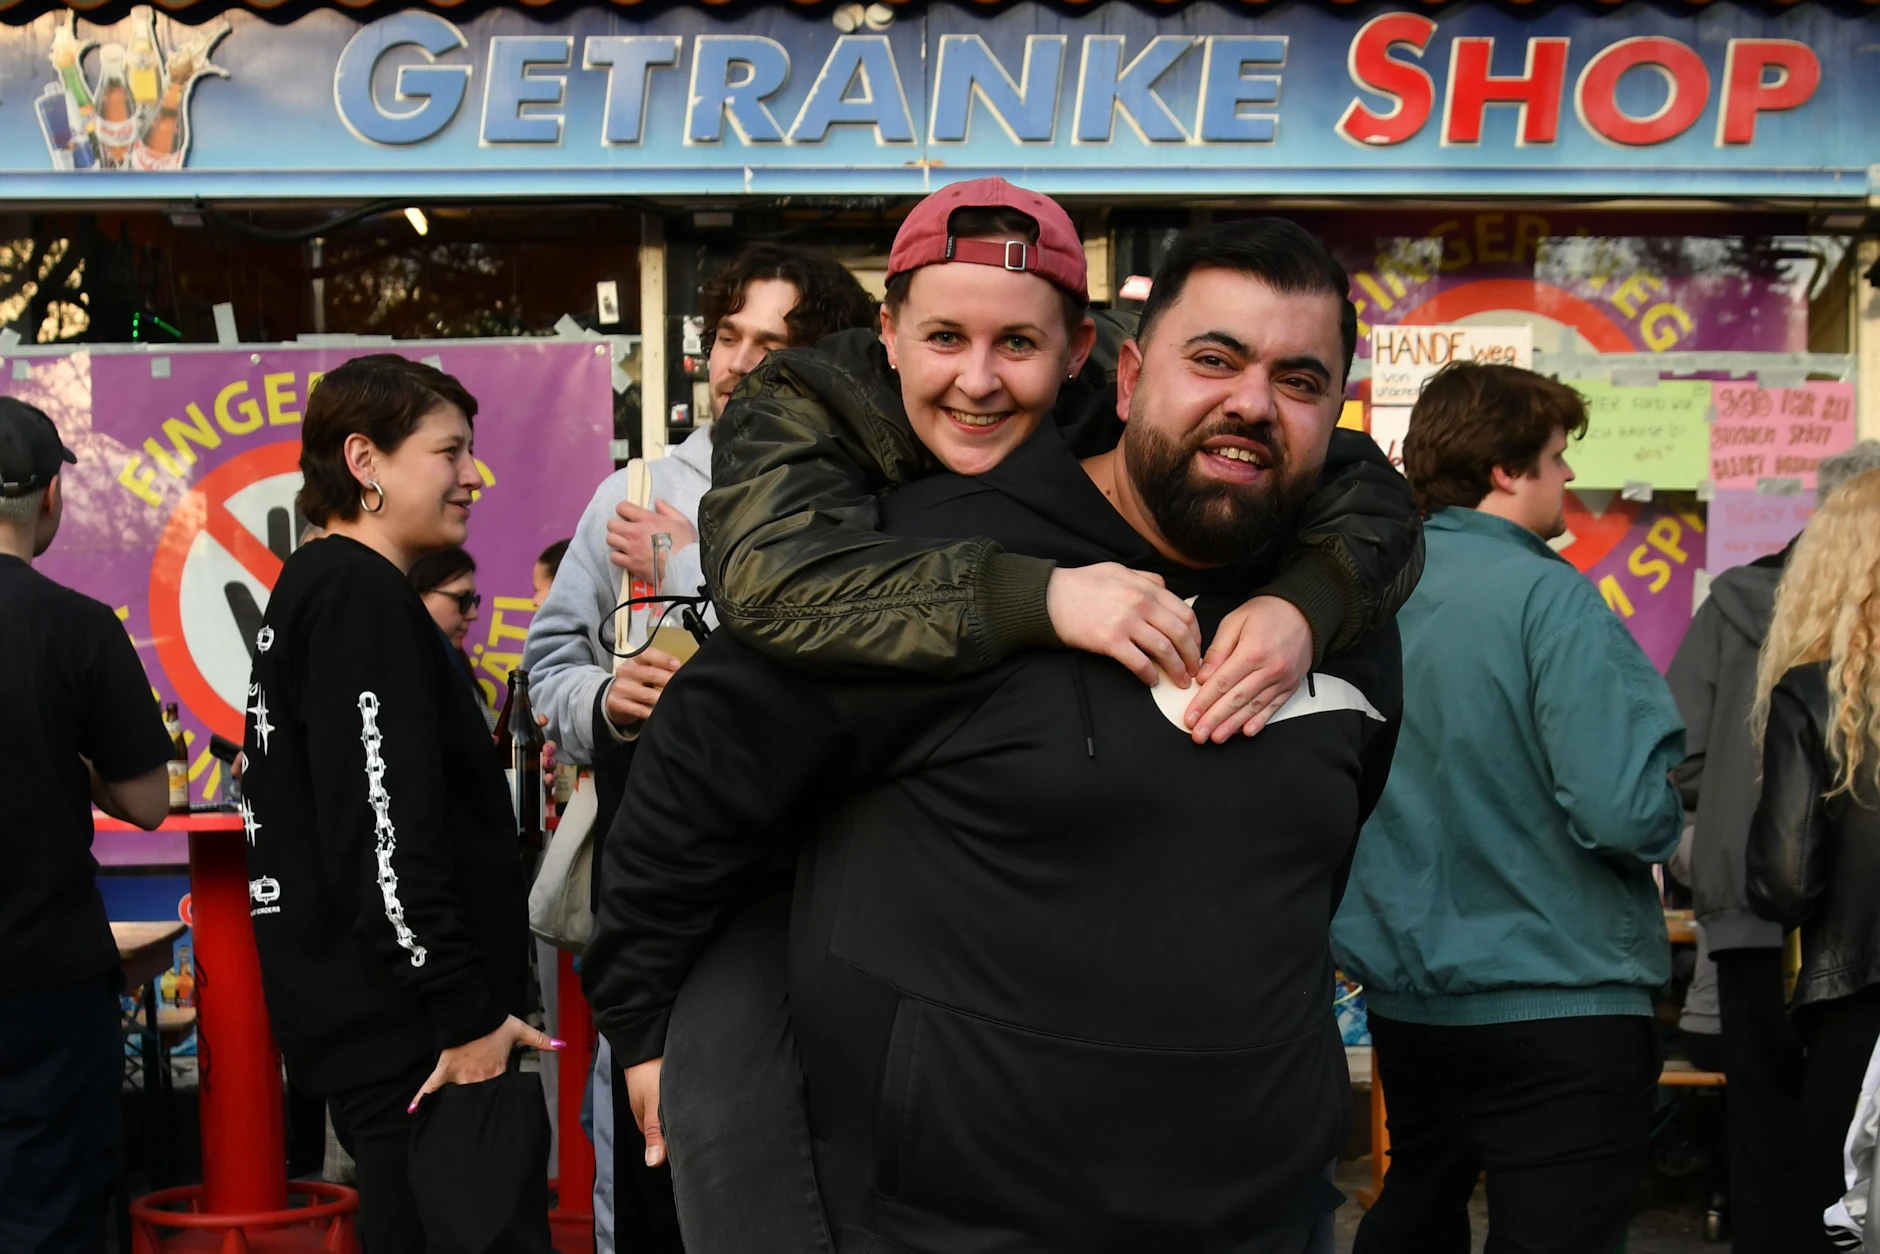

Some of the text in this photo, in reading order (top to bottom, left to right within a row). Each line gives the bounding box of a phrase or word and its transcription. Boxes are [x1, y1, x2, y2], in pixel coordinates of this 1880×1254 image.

[333, 4, 1823, 149] GETRÄNKE SHOP
[118, 371, 324, 508] FINGE
